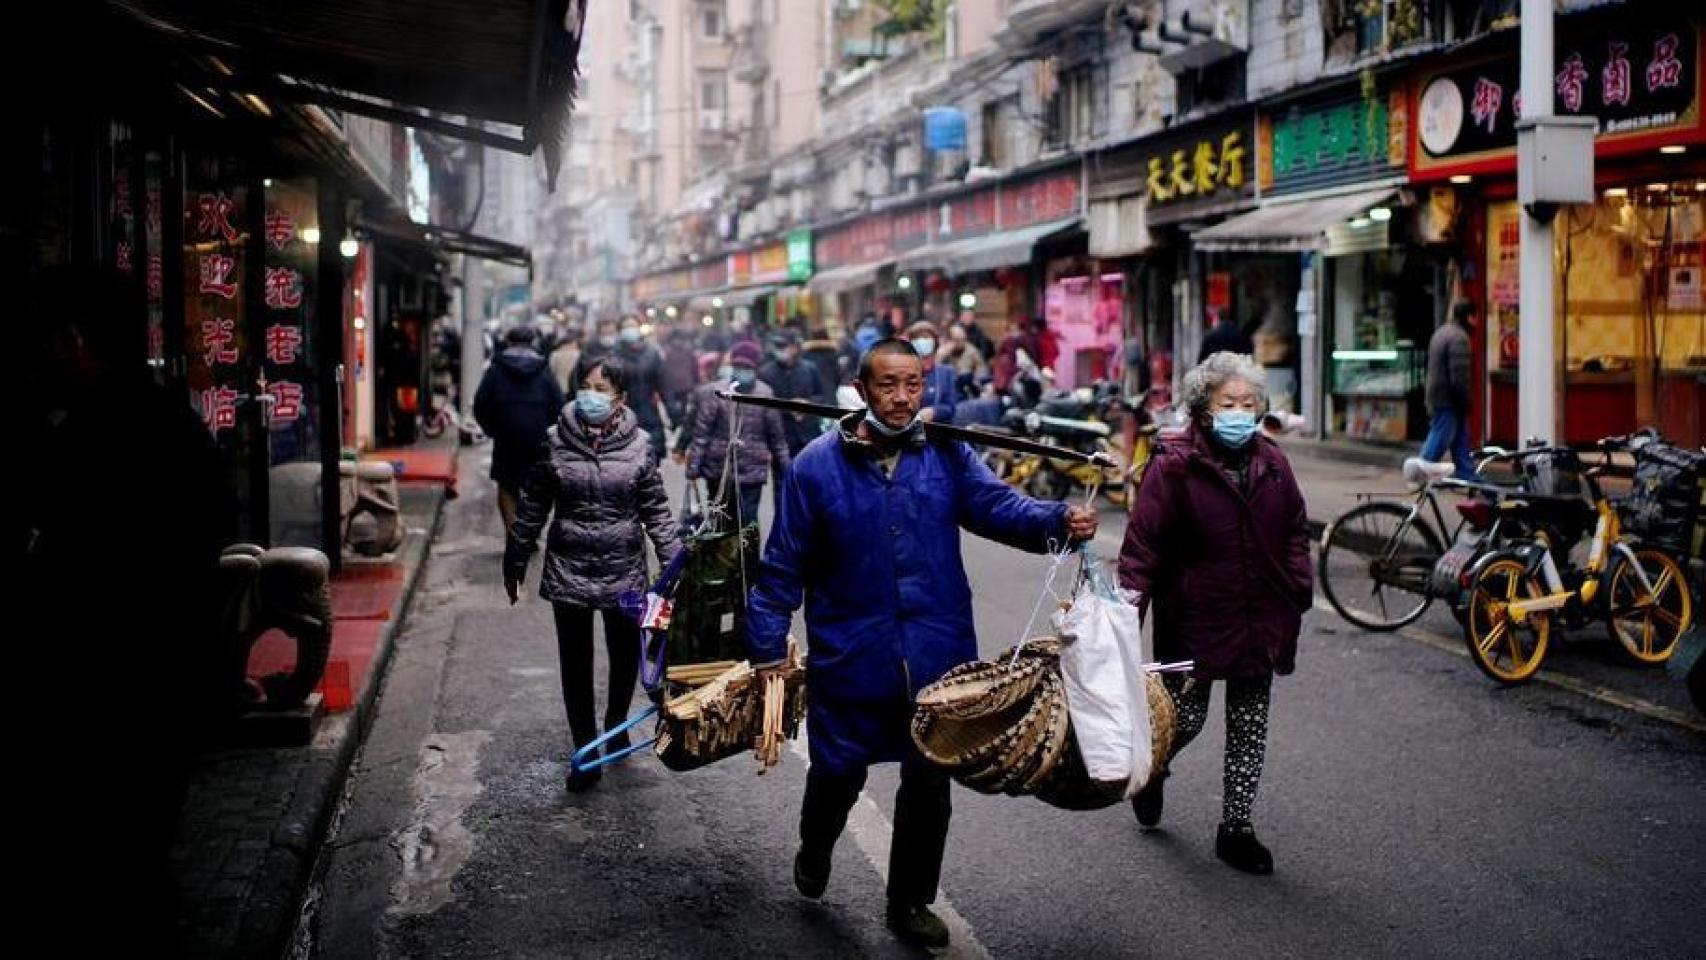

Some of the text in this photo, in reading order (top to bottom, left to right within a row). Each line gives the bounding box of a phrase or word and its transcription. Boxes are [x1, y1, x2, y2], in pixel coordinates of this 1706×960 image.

[1471, 32, 1683, 133] 御香卤品
[1146, 131, 1246, 204] 天天餐厅
[200, 194, 239, 434] 欢迎光临
